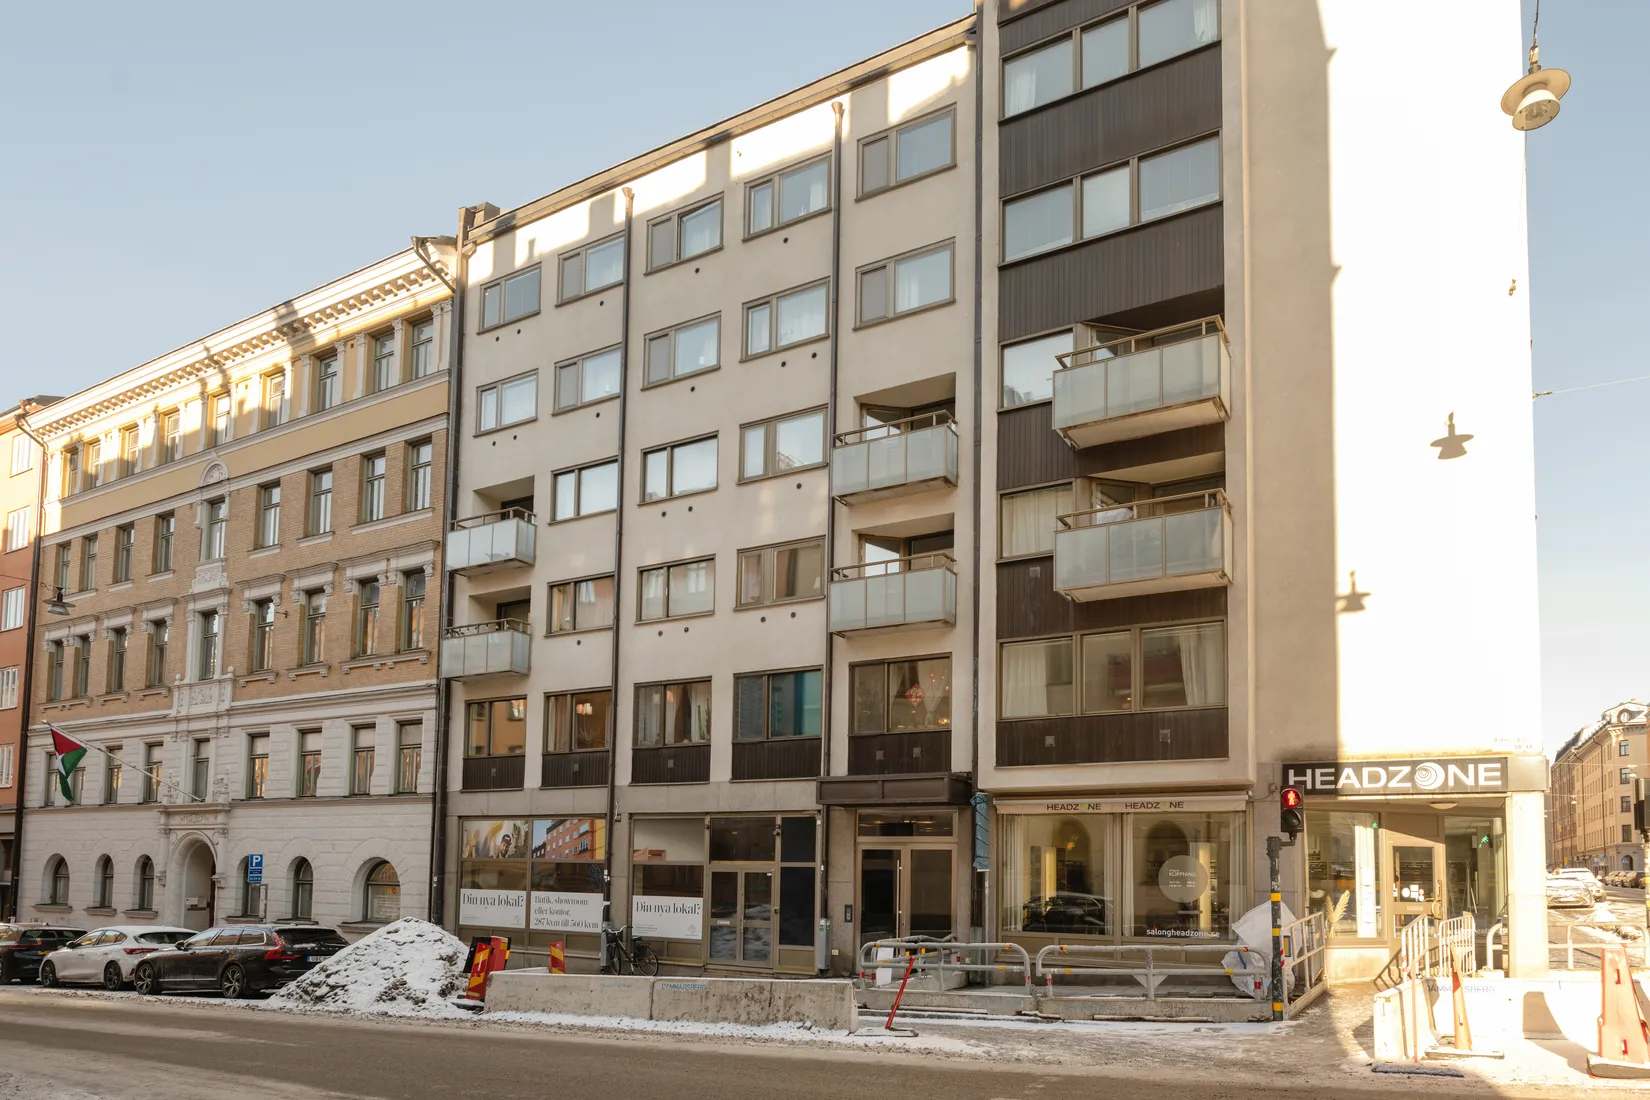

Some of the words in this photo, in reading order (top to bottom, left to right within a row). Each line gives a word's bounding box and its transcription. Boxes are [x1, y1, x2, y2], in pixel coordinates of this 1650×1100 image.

[1288, 762, 1502, 790] HEADZONE
[252, 855, 261, 867] P
[462, 893, 478, 905] Din
[479, 896, 496, 909] nya
[498, 894, 524, 908] lokal?
[555, 896, 588, 906] showroom
[534, 906, 549, 915] eller
[636, 901, 652, 913] Din
[654, 904, 671, 917] nya
[673, 902, 701, 915] lokal?
[534, 917, 546, 926] 287
[546, 918, 560, 927] kvm
[560, 919, 570, 927] till
[584, 920, 599, 929] kvm
[1146, 927, 1220, 938] salongheadzone.se
